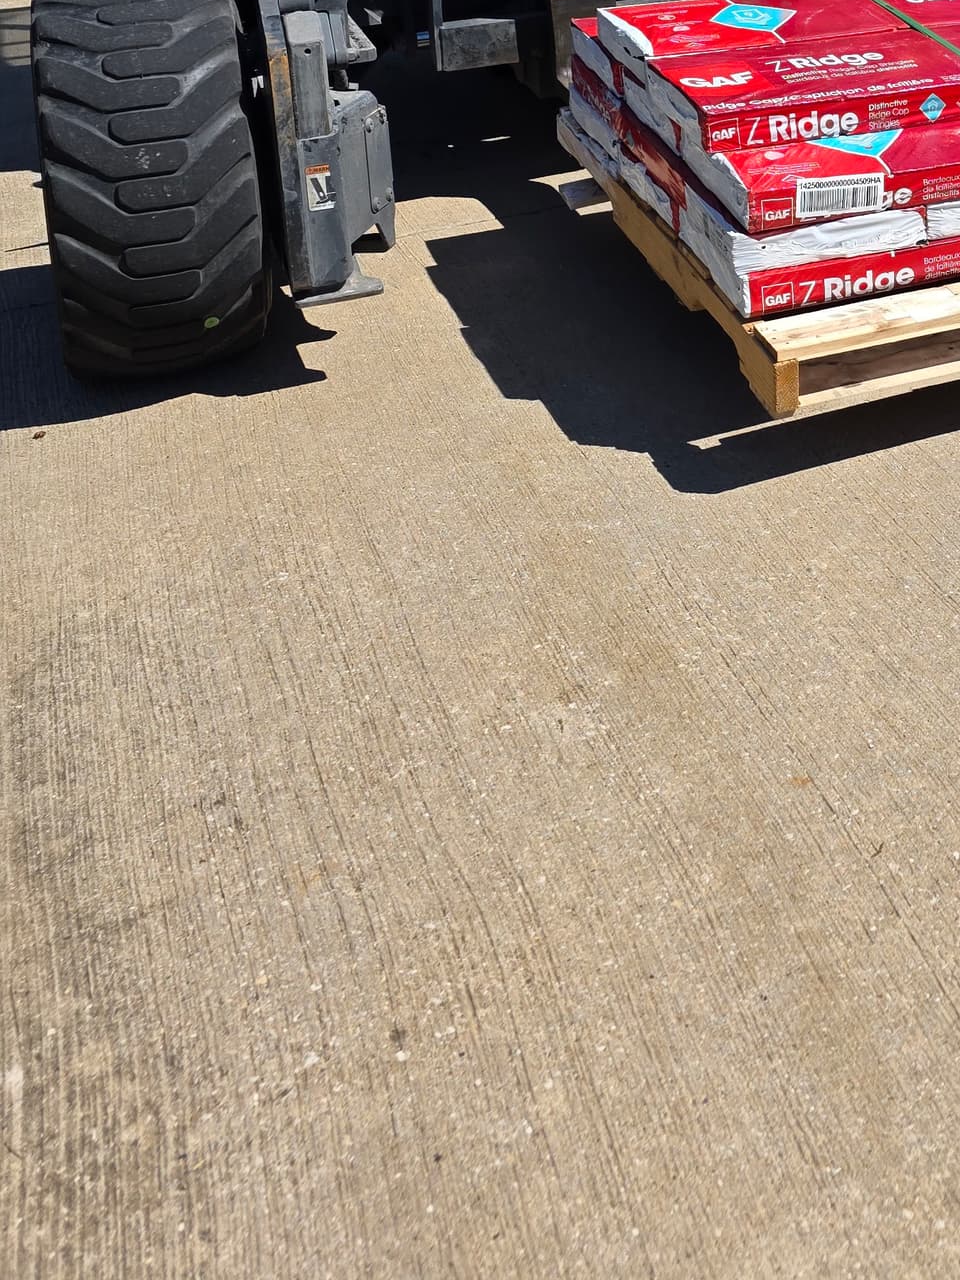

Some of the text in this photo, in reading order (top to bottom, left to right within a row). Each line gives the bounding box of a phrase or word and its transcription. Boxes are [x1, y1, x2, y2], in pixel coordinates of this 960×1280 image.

[765, 52, 884, 73] Z Ridge
[679, 71, 753, 88] GAF
[868, 99, 908, 112] Distinctive
[868, 108, 910, 121] Ridge Cap
[712, 110, 860, 146] GAF Z Ridge
[868, 119, 900, 131] Shingles
[765, 208, 791, 221] GAF
[765, 267, 915, 307] GAF Z Ridge
